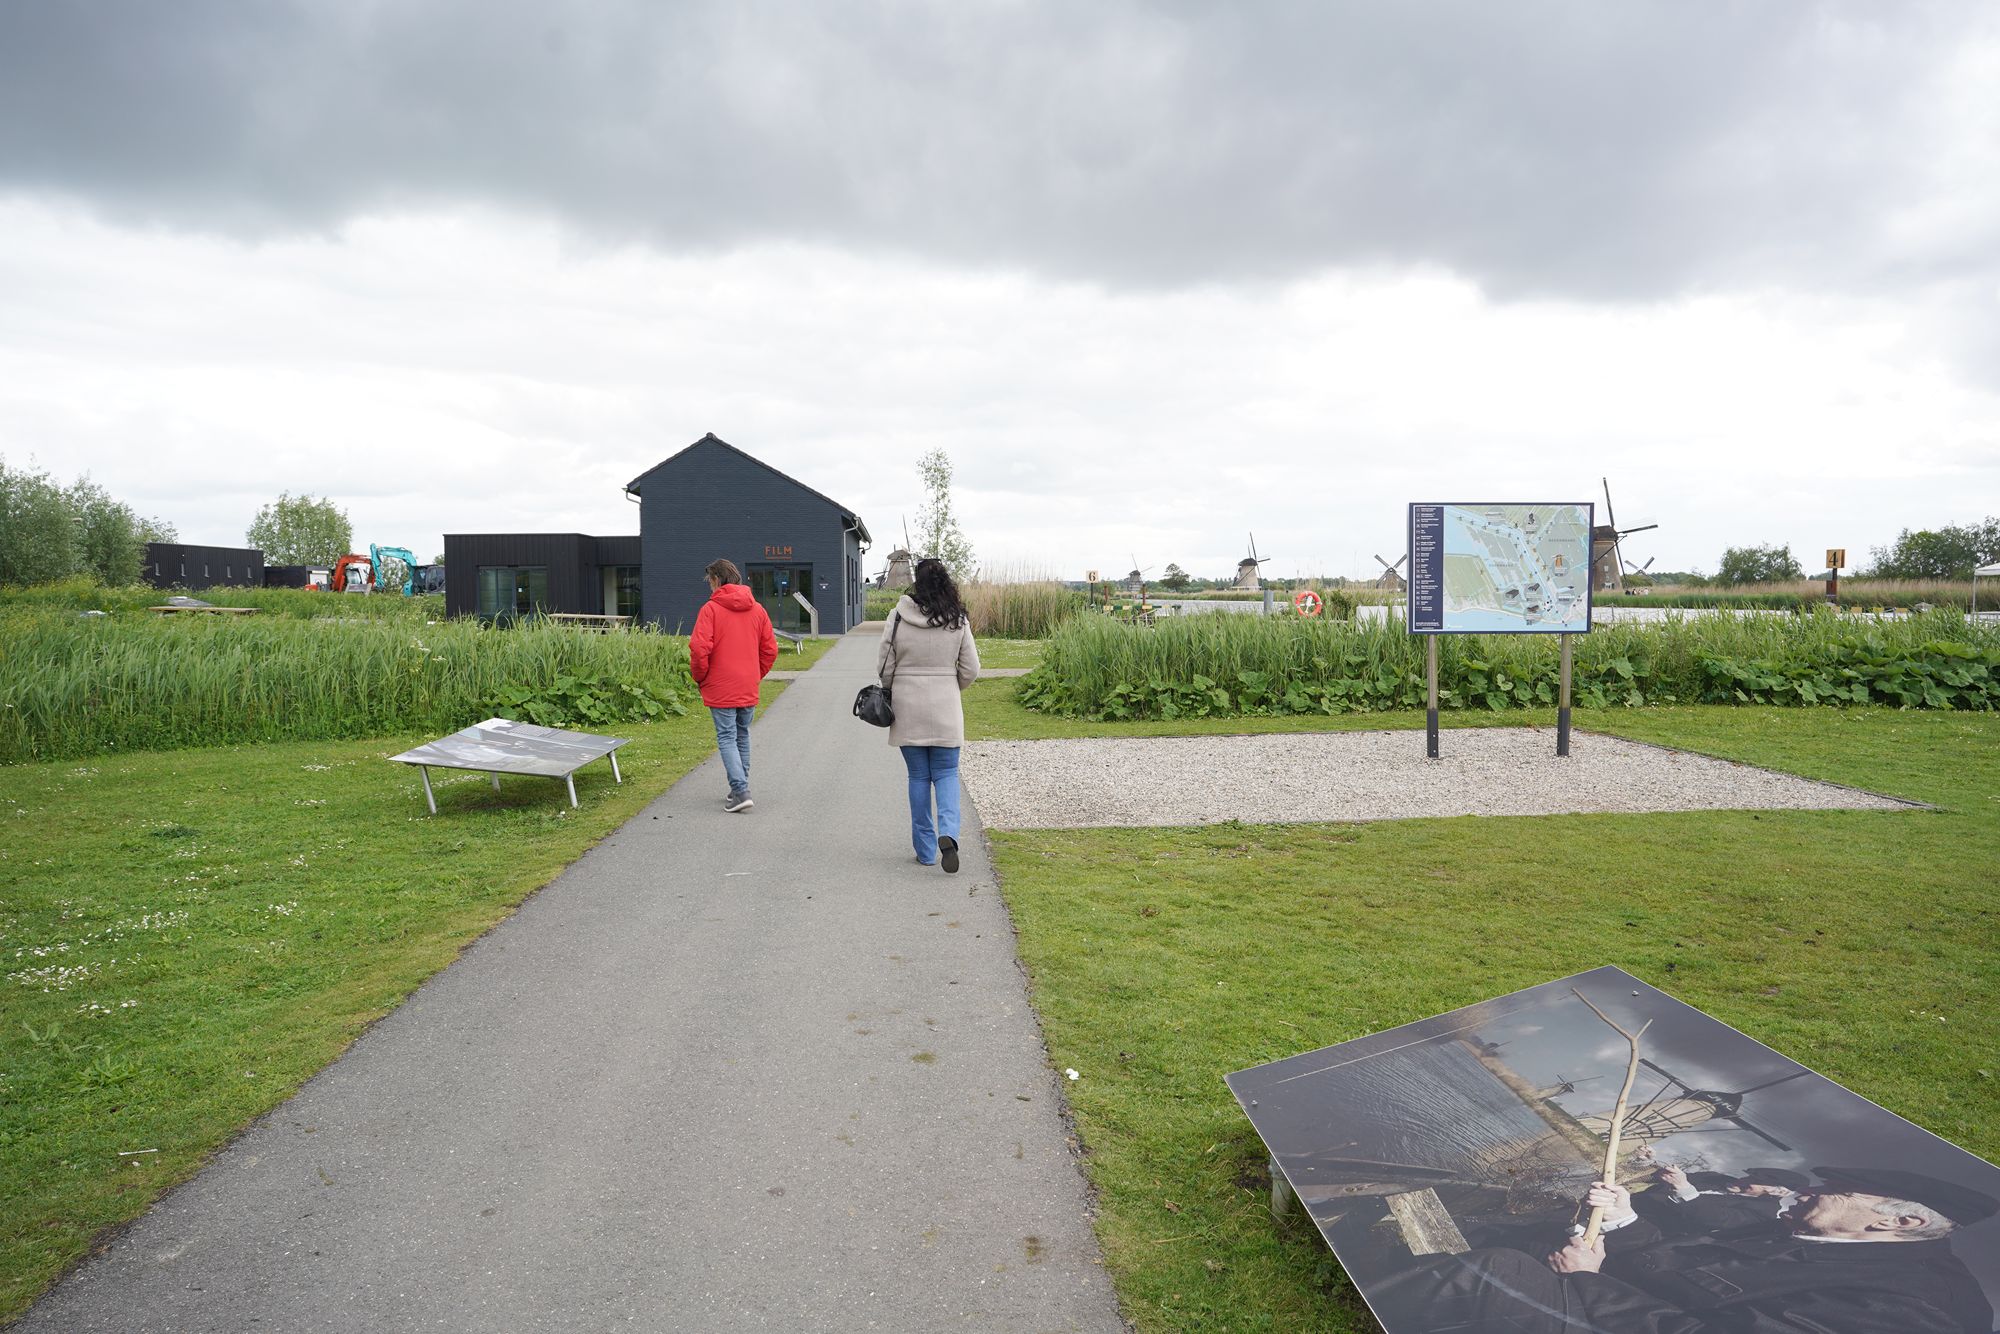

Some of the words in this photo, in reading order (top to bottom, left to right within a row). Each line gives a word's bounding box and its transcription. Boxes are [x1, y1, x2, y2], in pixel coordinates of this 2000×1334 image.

[765, 545, 792, 556] FILM
[1829, 551, 1839, 566] 4
[1088, 571, 1096, 581] 6
